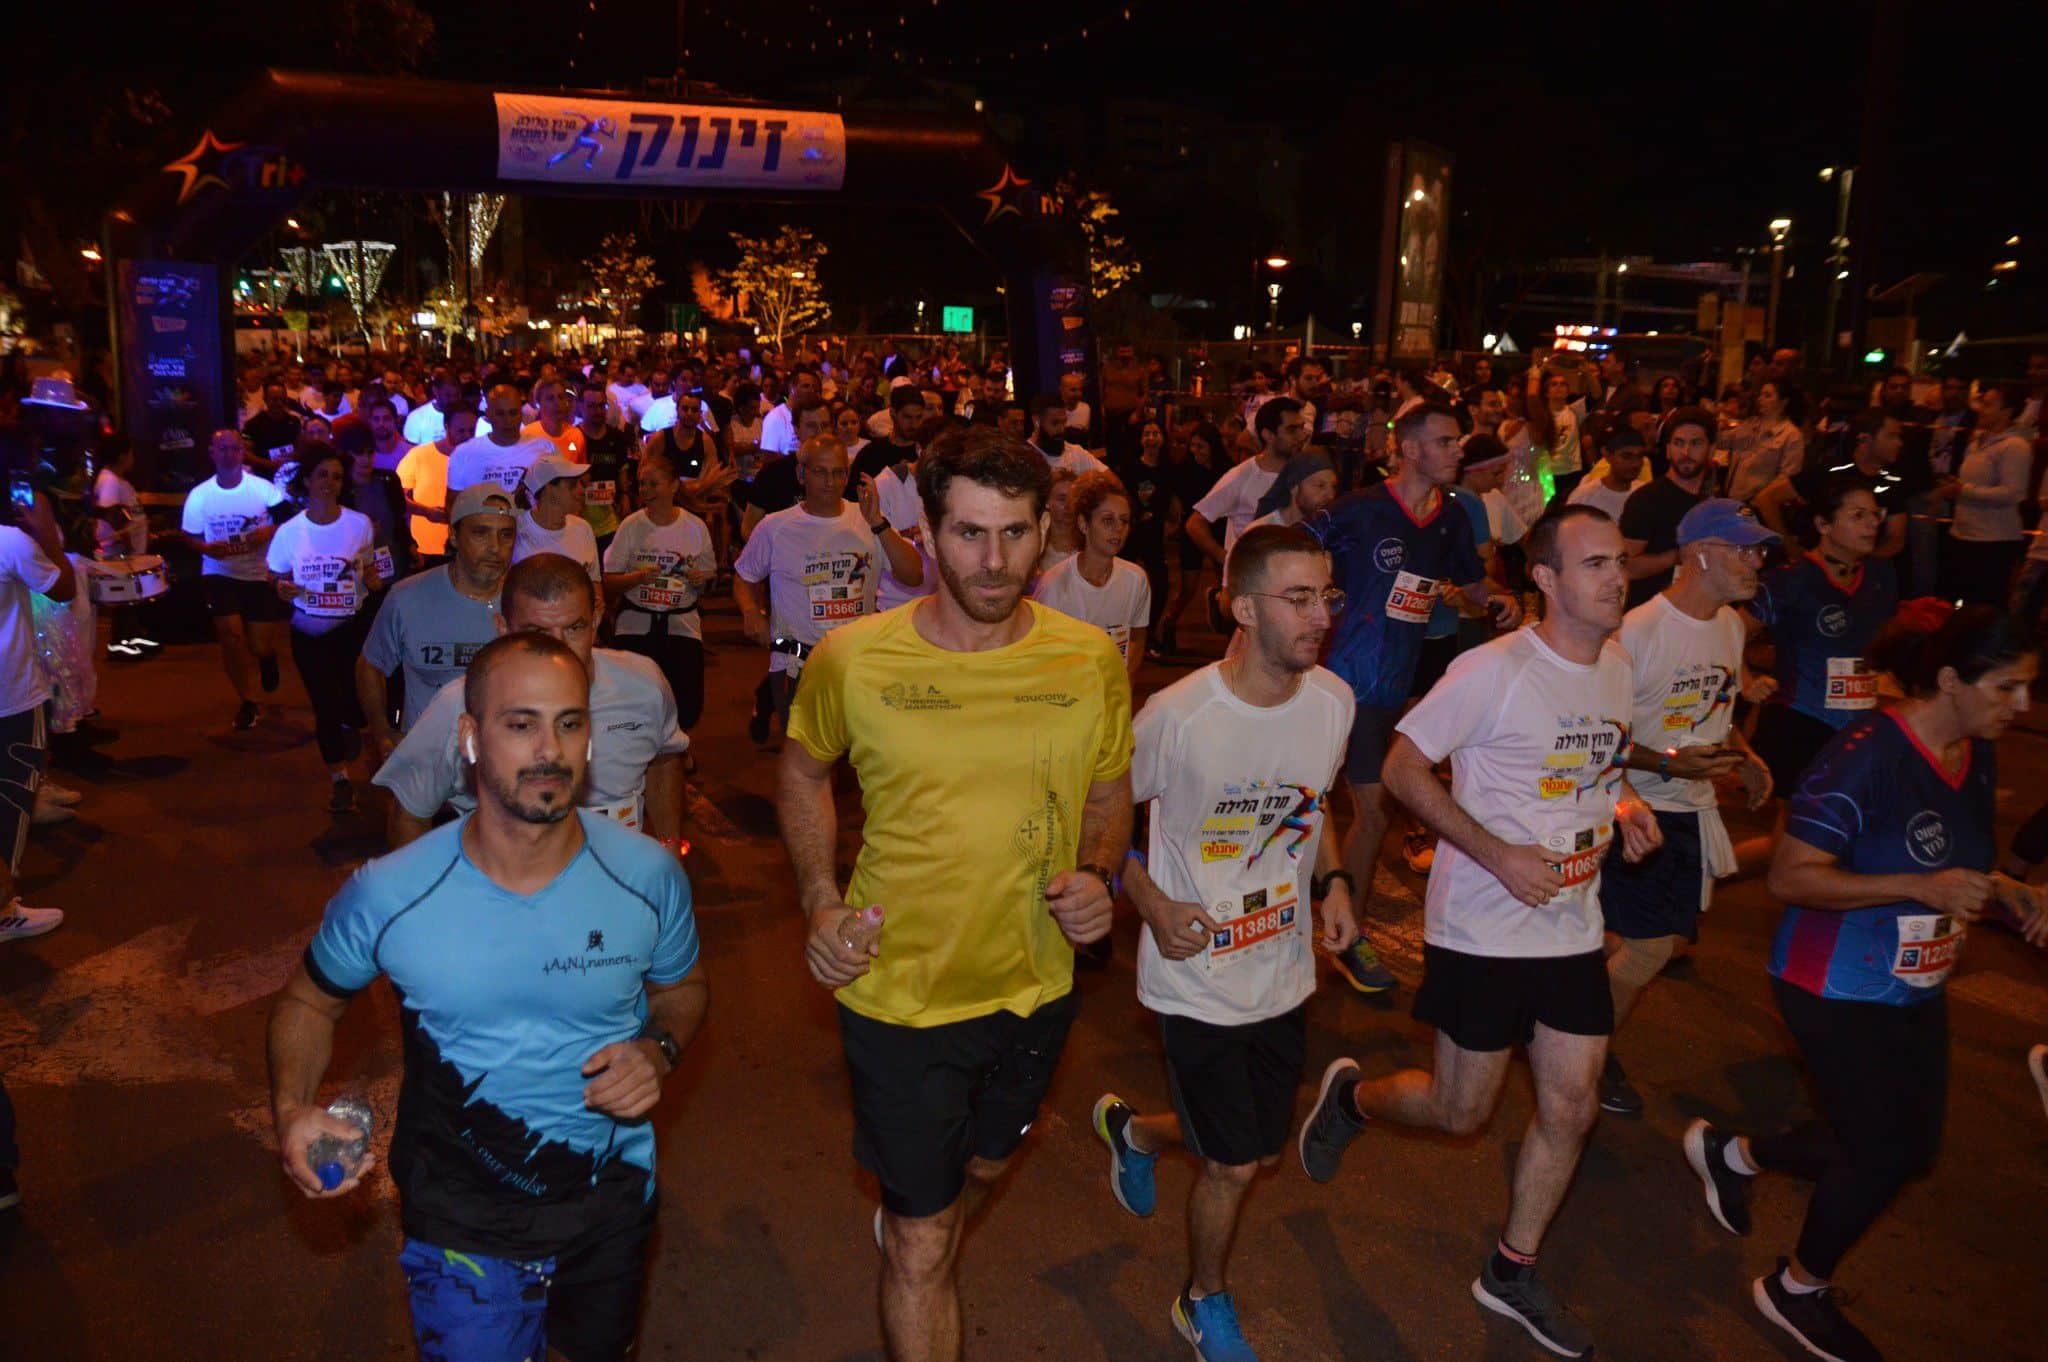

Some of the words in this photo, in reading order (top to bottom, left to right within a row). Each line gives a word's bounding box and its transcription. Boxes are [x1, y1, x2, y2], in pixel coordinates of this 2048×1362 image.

[616, 113, 788, 179] זינוק
[420, 645, 444, 665] 12
[1013, 693, 1068, 704] saucony
[1554, 732, 1589, 750] הלילה
[1591, 731, 1614, 749] מרוץ
[1591, 750, 1606, 765] של
[1214, 798, 1259, 814] הלילה
[1235, 912, 1278, 942] 1388
